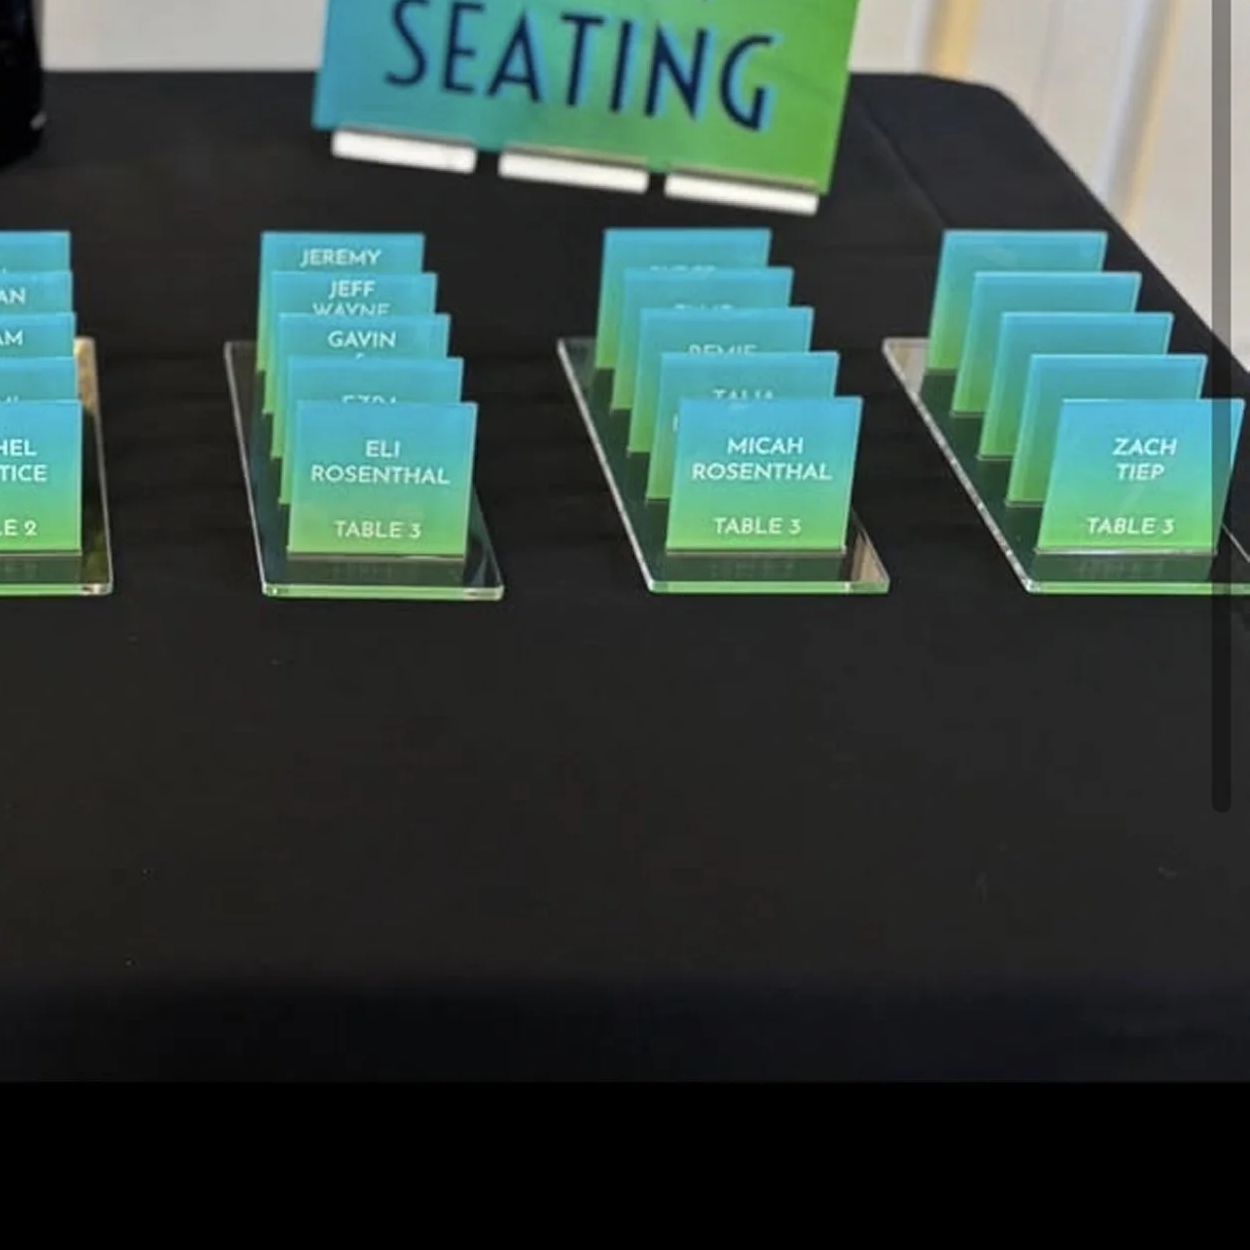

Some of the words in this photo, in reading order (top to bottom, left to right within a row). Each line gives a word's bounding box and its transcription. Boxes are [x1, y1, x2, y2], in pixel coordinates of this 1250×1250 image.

[300, 248, 382, 268] JEREMY
[328, 279, 375, 299] JEFF
[327, 330, 396, 347] GAVIN
[365, 441, 400, 458] ELI
[727, 437, 803, 454] MICAH
[1112, 438, 1177, 456] ZACH
[312, 466, 450, 485] ROSENTHAL
[691, 463, 832, 481] ROSENTHAL
[1116, 464, 1165, 481] TIEP
[24, 520, 37, 536] 2
[335, 521, 401, 538] TABLE
[409, 522, 422, 539] 3
[713, 518, 782, 534] TABLE
[789, 518, 802, 534] 3
[1088, 517, 1155, 535] TABLE
[1162, 518, 1175, 534] 3
